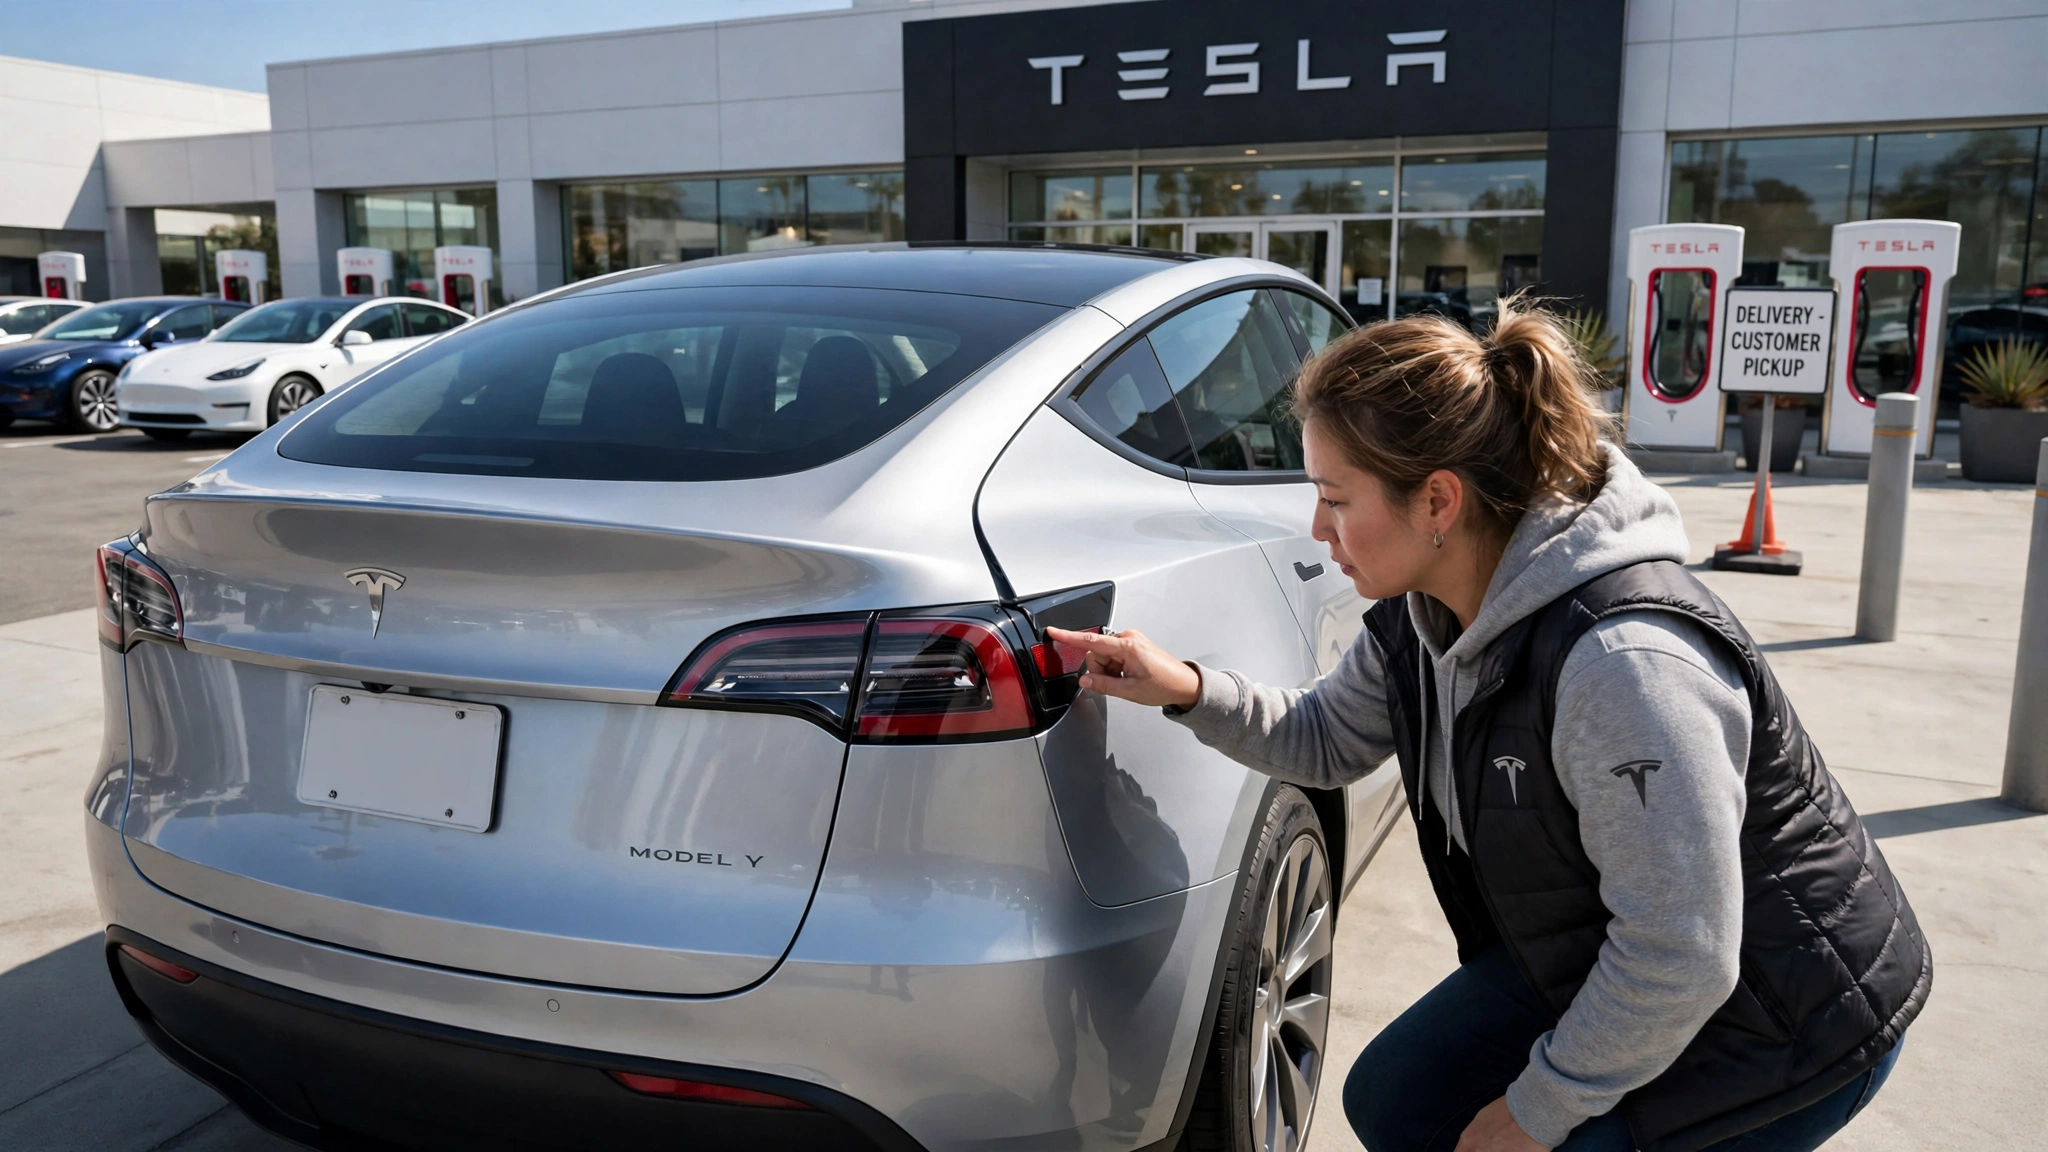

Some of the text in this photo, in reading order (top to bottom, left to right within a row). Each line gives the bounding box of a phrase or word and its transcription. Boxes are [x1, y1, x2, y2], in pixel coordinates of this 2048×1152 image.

[1027, 29, 1448, 105] TESLA
[1650, 243, 1719, 254] TESLA
[1858, 240, 1935, 252] TESLA
[1736, 305, 1814, 324] DELIVERY
[1731, 331, 1821, 352] CUSTOMER
[1743, 357, 1805, 377] PICKUP
[629, 846, 764, 868] MODEL Y
